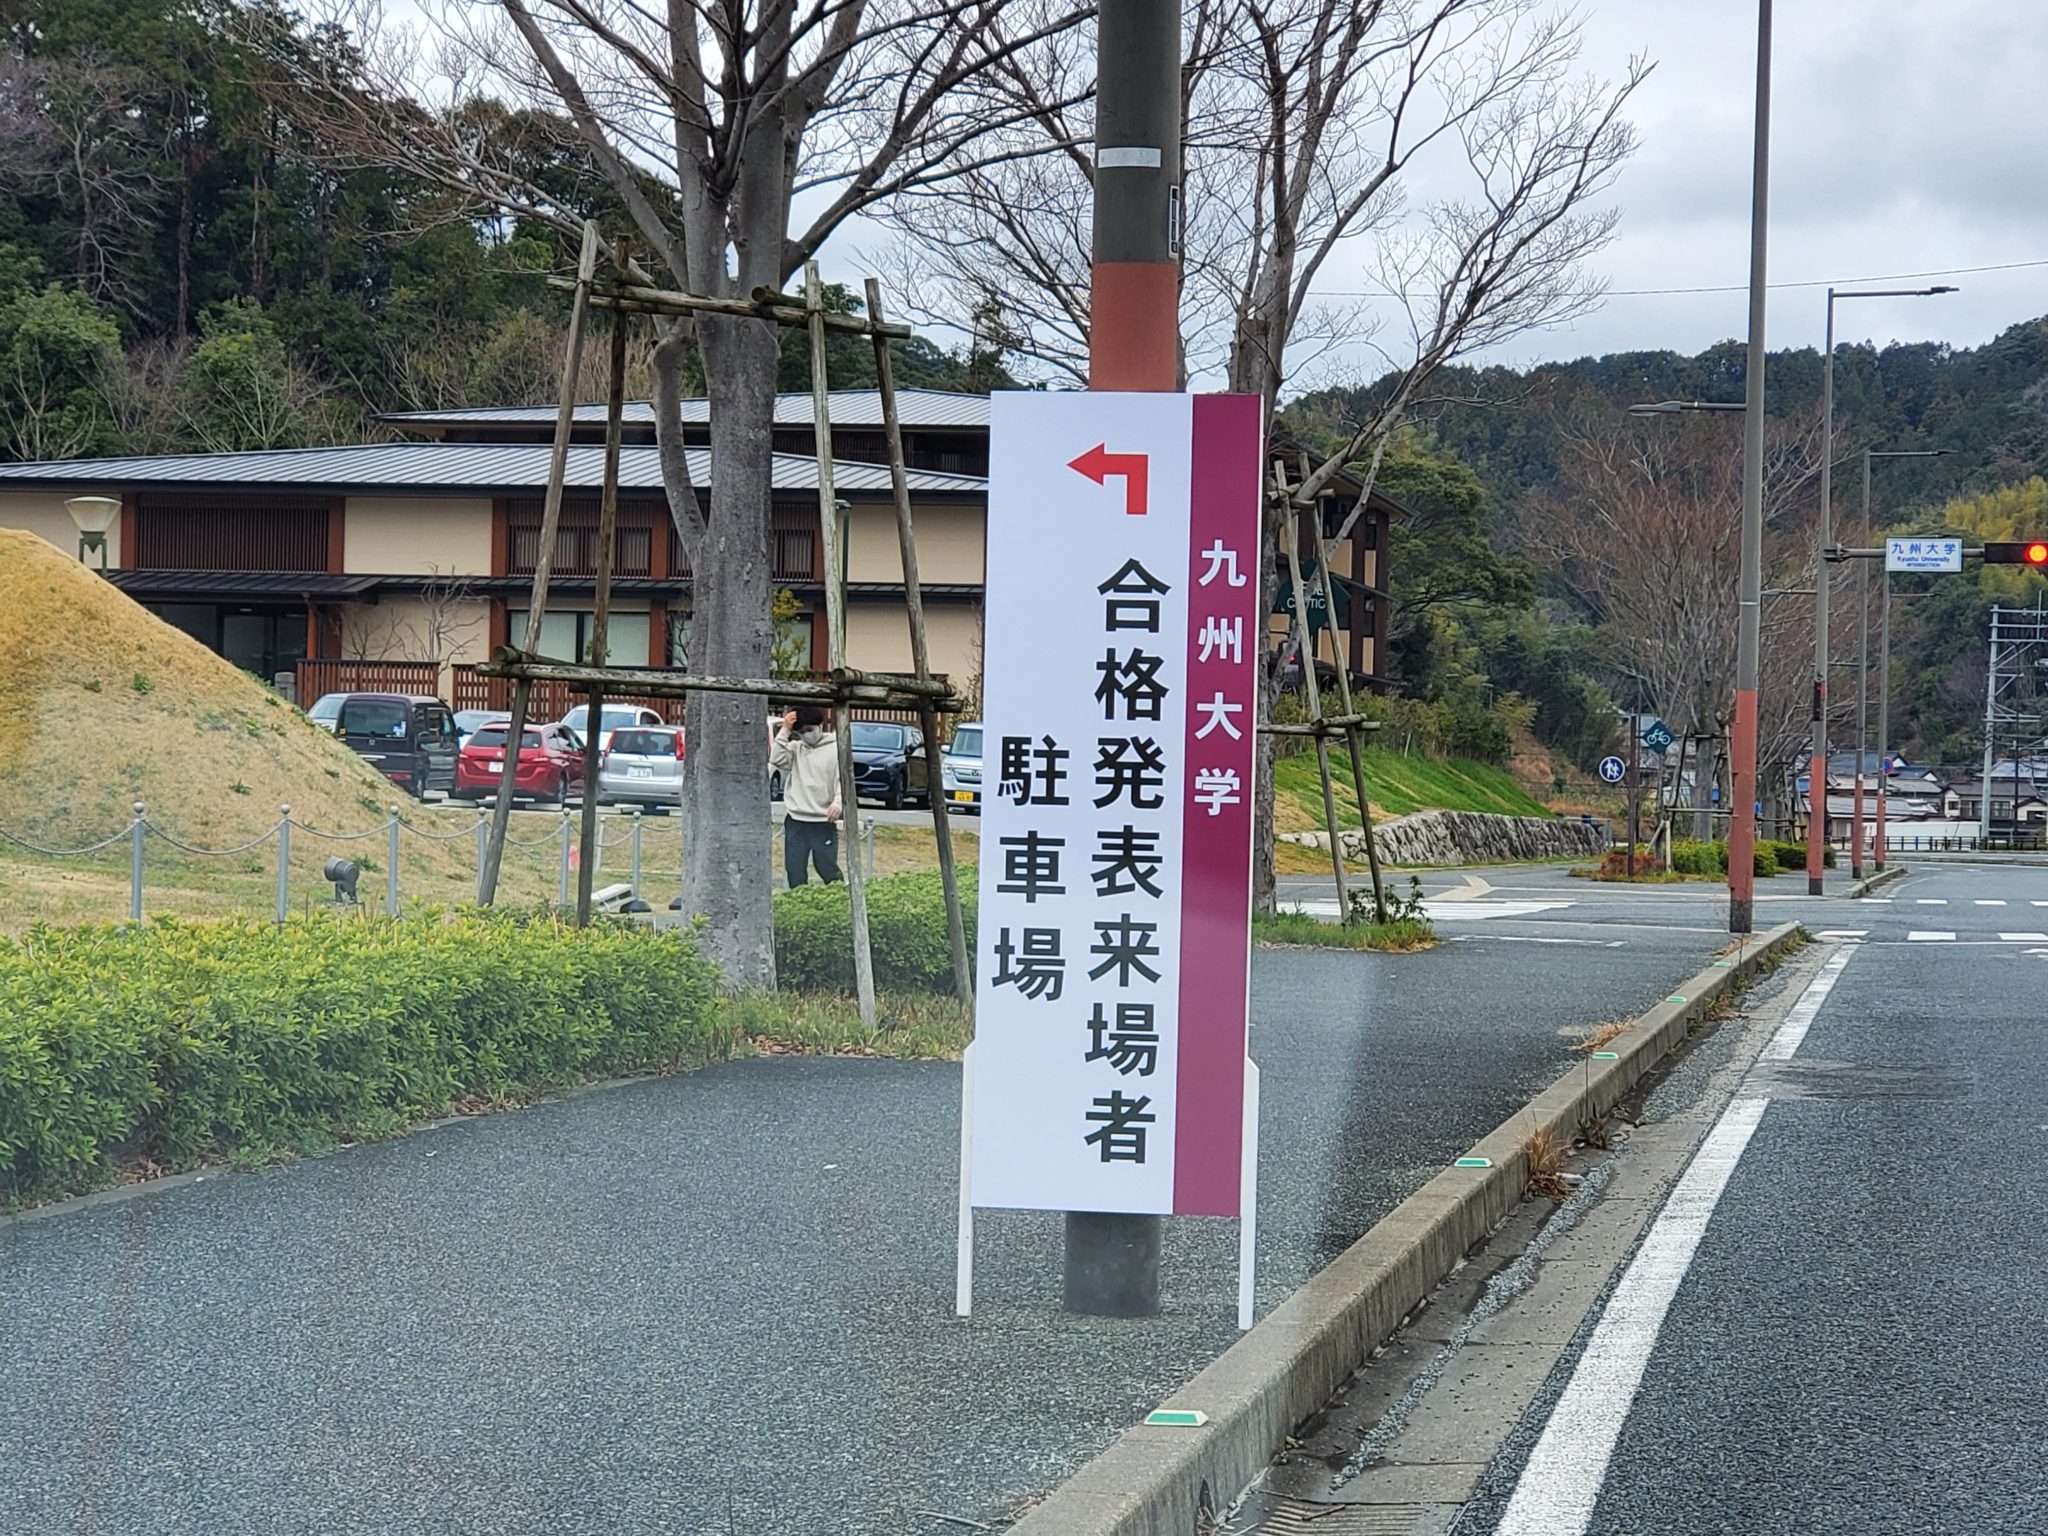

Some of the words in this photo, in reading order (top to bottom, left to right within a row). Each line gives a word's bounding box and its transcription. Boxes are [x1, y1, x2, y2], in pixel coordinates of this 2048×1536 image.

[1194, 539, 1247, 816] 九州大学
[1892, 543, 1956, 555] 九州大学
[991, 733, 1070, 1002] 駐車場
[1084, 557, 1172, 1165] 合格発表来場者
